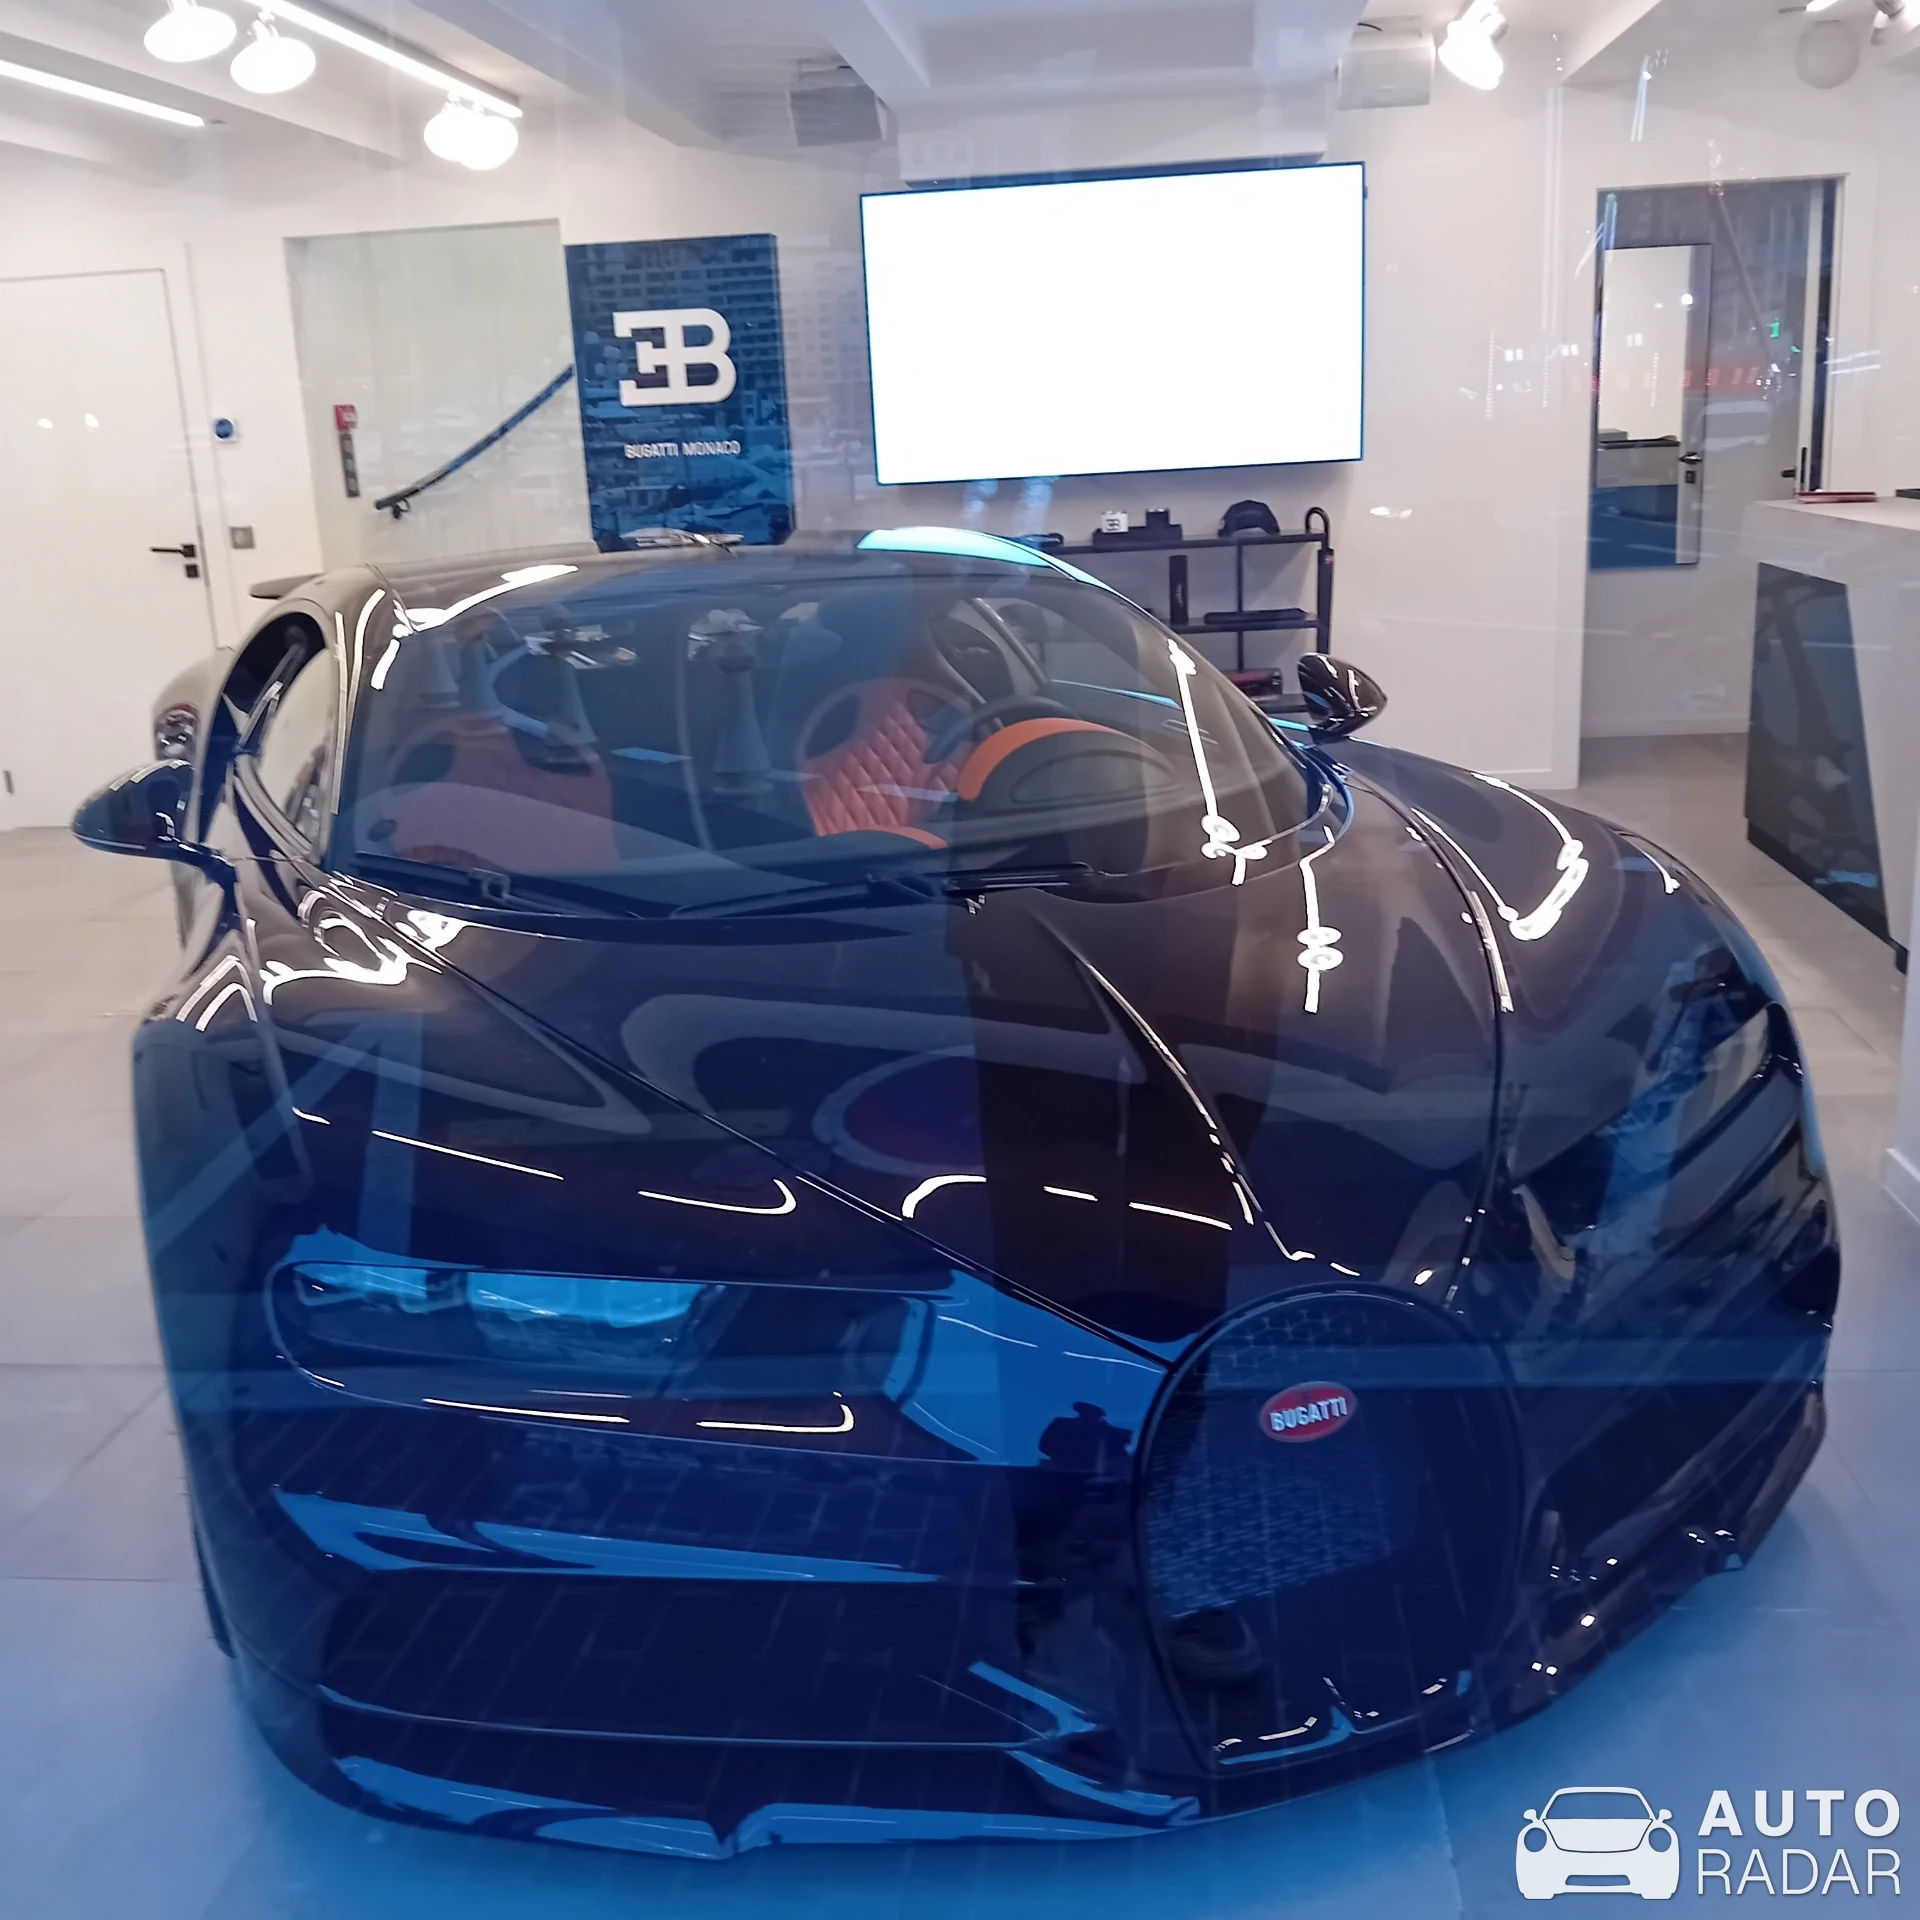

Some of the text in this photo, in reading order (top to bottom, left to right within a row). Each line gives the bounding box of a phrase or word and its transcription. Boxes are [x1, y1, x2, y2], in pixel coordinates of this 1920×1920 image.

[624, 440, 742, 459] BUGATTI MONACO
[1269, 1396, 1348, 1432] BUGATTI
